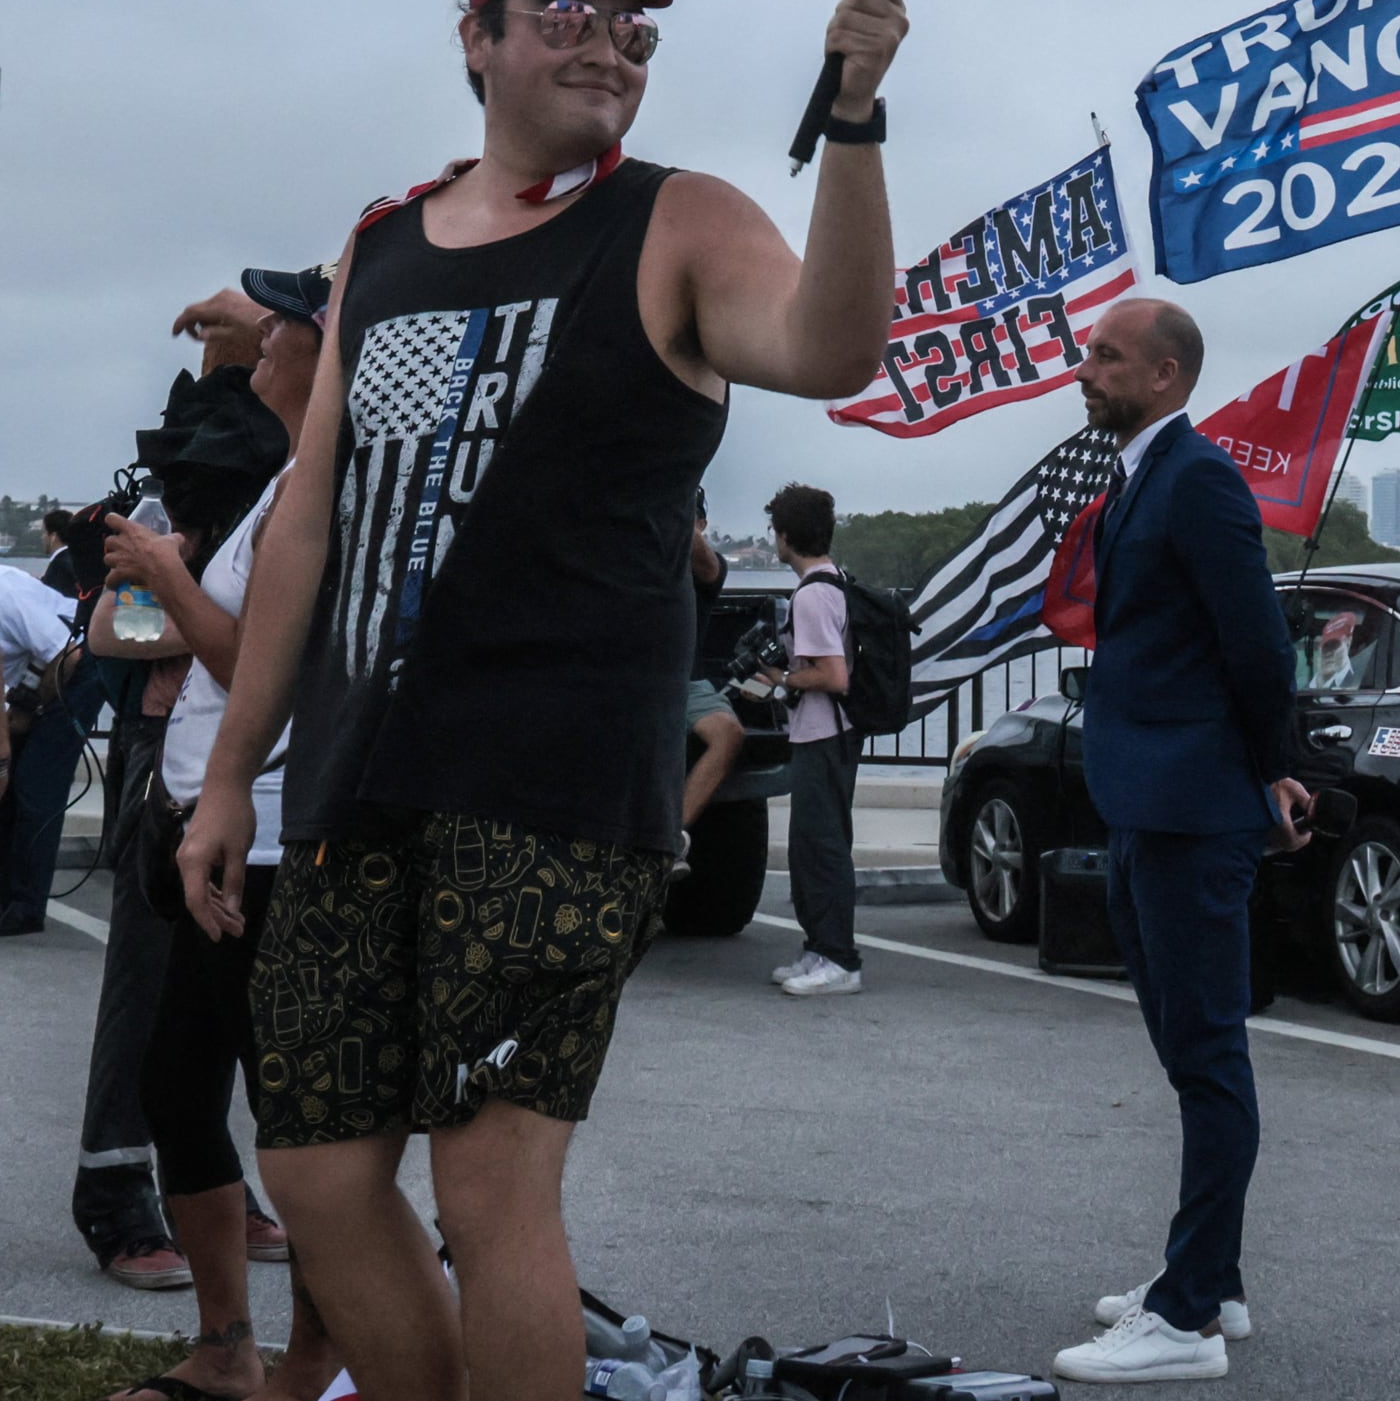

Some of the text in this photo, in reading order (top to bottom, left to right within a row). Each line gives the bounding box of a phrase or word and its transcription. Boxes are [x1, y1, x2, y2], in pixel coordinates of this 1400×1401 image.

[407, 357, 475, 572] BACK THE BLUE
